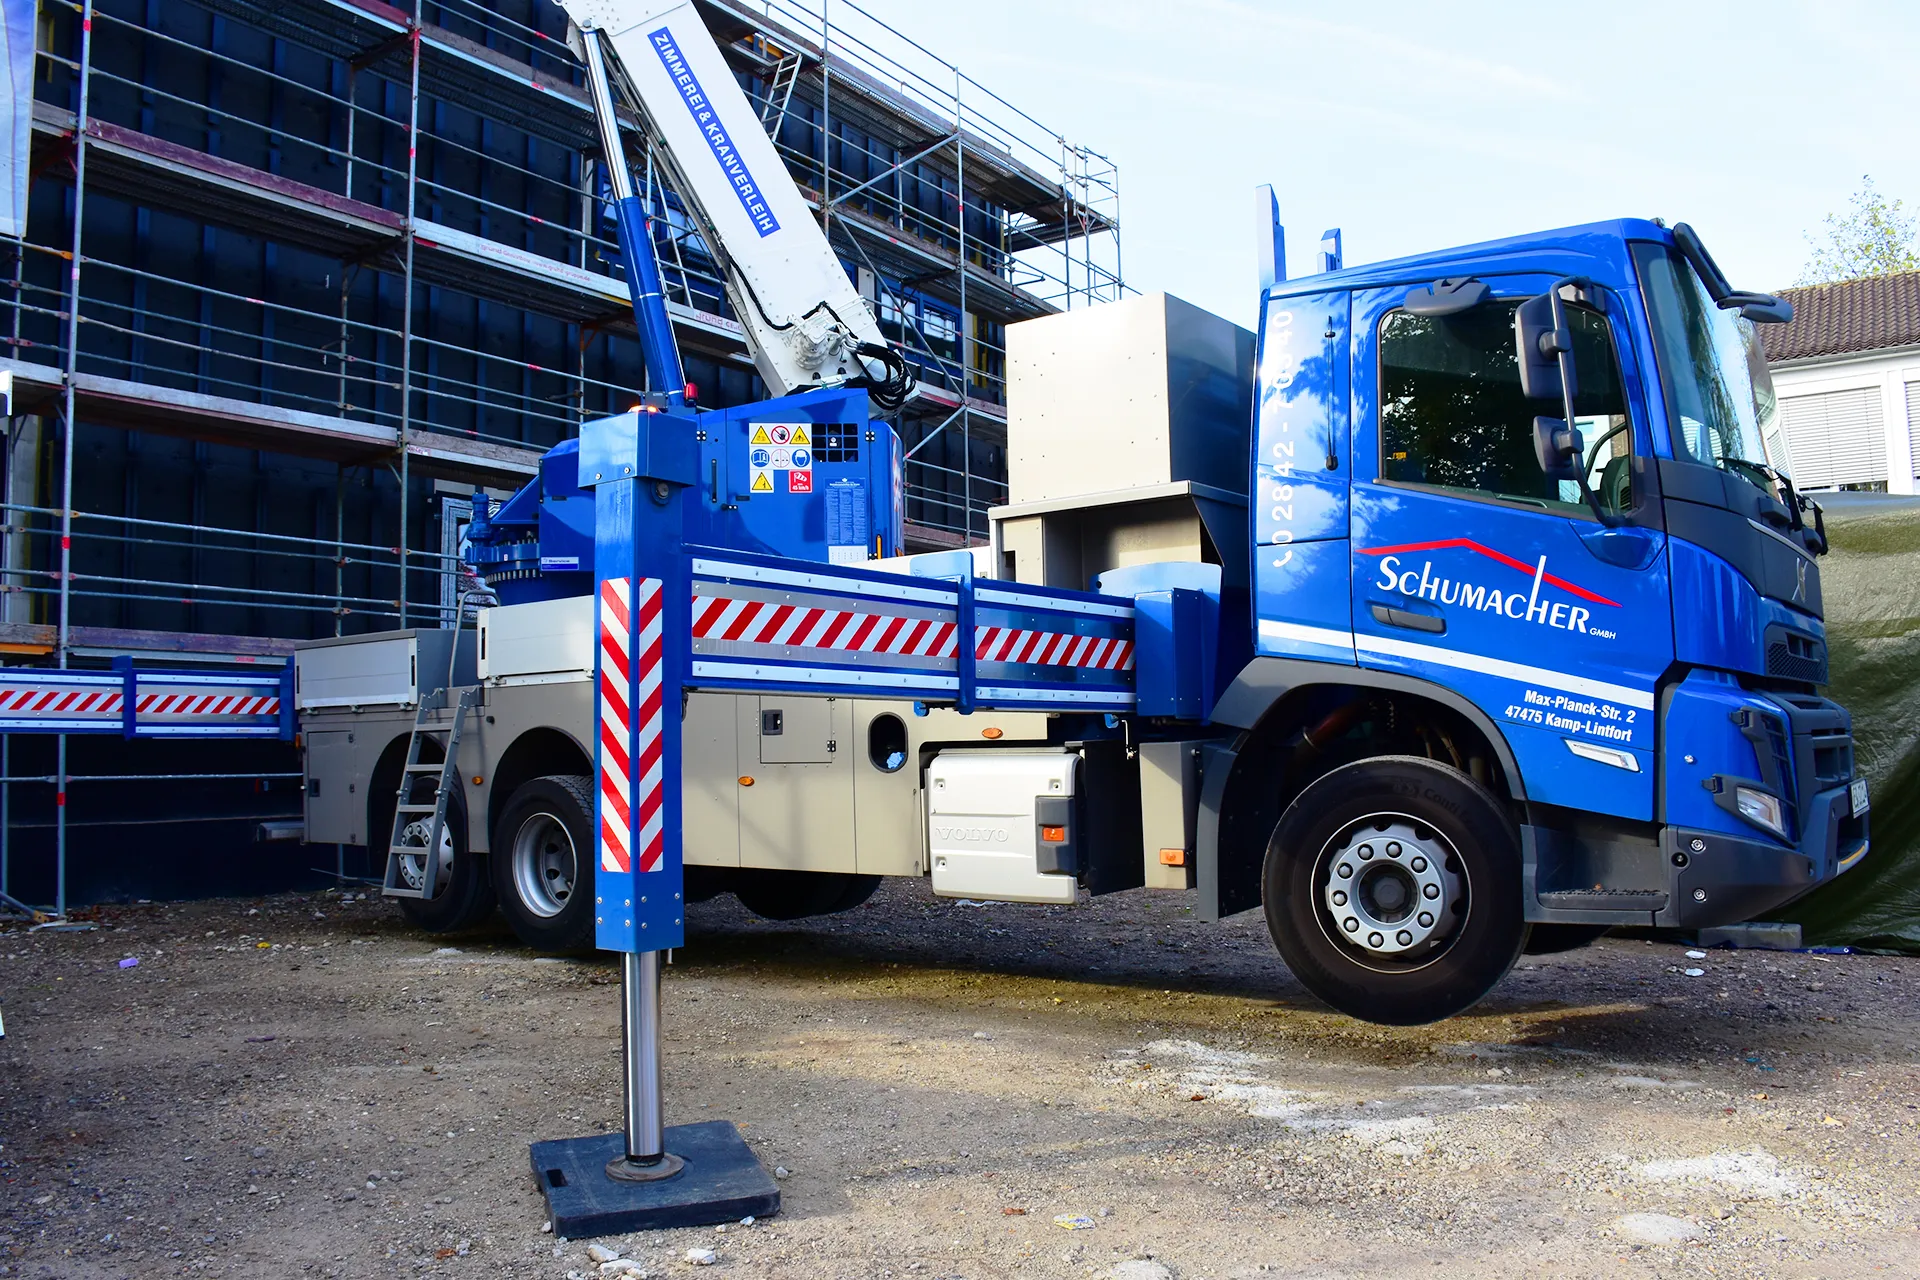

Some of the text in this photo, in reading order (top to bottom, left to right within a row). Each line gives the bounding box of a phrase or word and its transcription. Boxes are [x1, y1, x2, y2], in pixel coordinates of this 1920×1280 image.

[654, 33, 774, 232] ZIMMEREI & KRANVERLEIH
[1271, 440, 1294, 547] 02842
[1589, 627, 1617, 640] GMBH
[1505, 705, 1633, 742] 47475 Kamp-Lintfort
[1524, 689, 1637, 723] Max-Planck-Str. 2
[936, 827, 1009, 842] VOLVO
